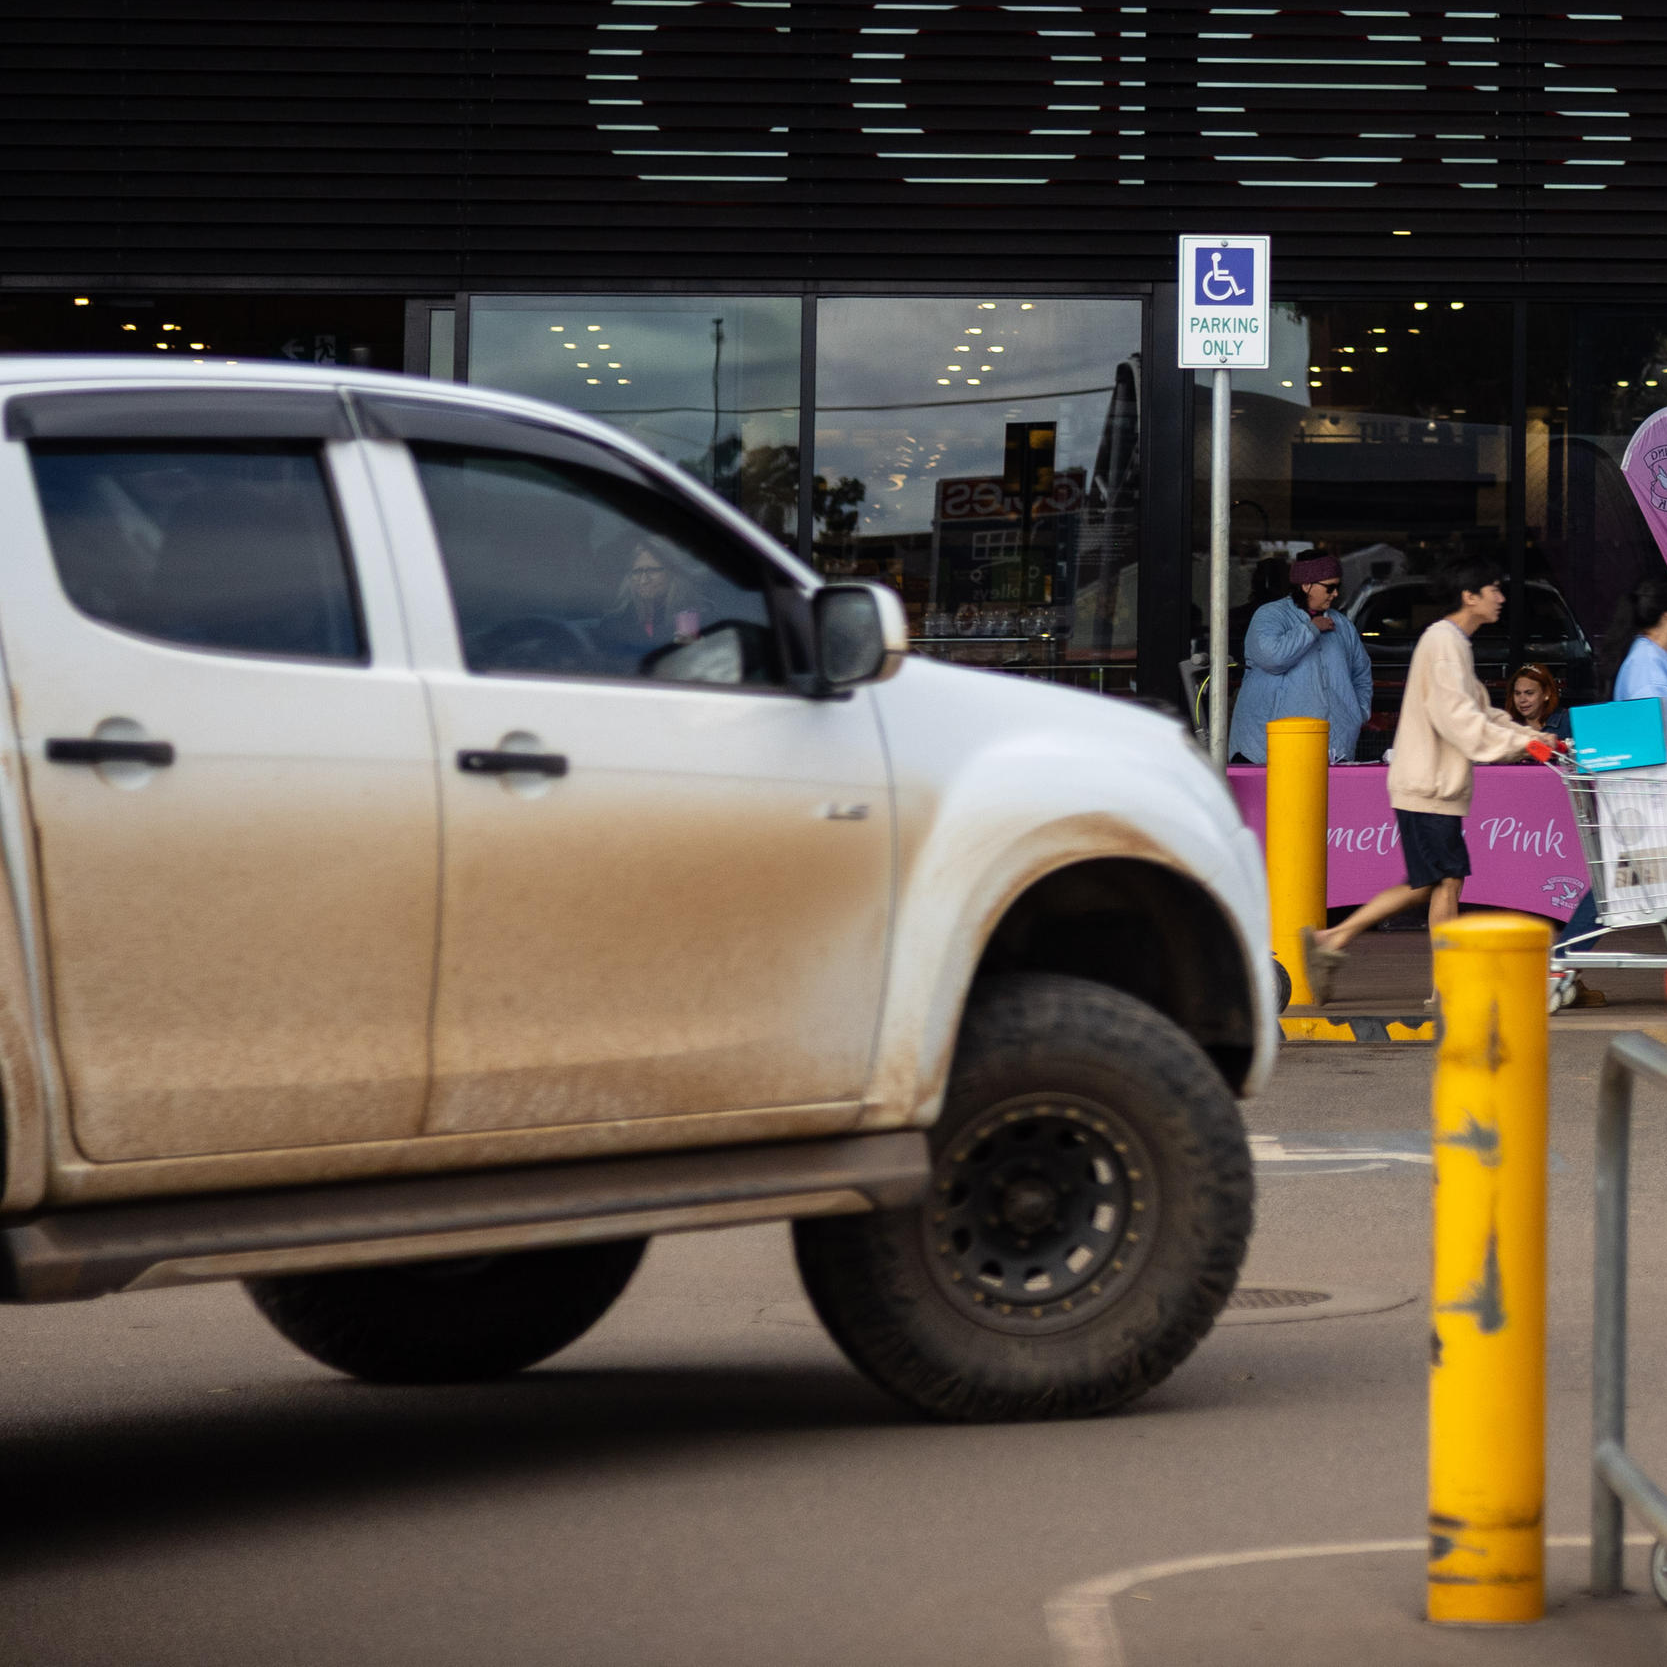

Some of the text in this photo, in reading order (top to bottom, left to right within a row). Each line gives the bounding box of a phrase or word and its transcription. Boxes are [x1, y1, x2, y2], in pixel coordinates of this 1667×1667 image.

[1190, 317, 1259, 334] PARKING
[1202, 339, 1243, 356] ONLY
[1480, 817, 1566, 859] Pink
